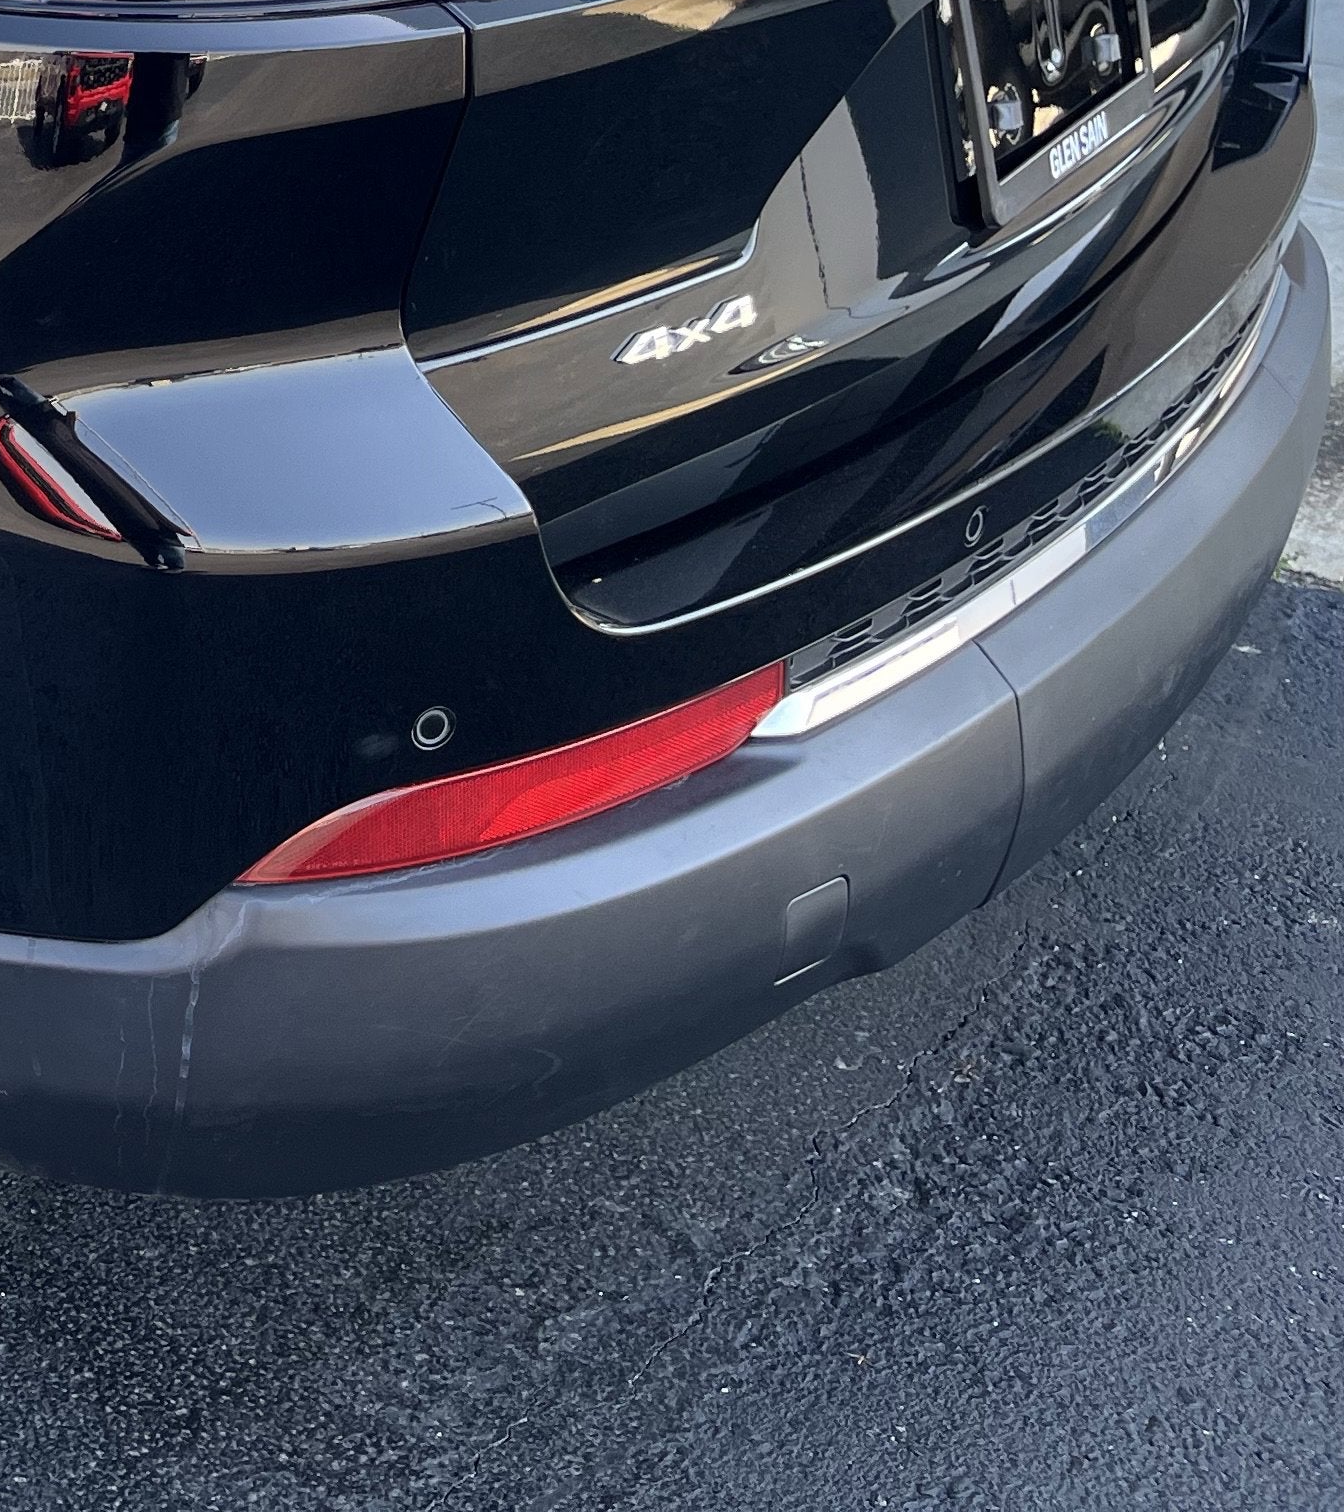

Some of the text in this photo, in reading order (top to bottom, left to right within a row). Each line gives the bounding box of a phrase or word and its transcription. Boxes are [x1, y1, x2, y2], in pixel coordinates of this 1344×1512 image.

[1049, 110, 1109, 180] GLEN SAIN
[611, 293, 758, 365] 4x4
